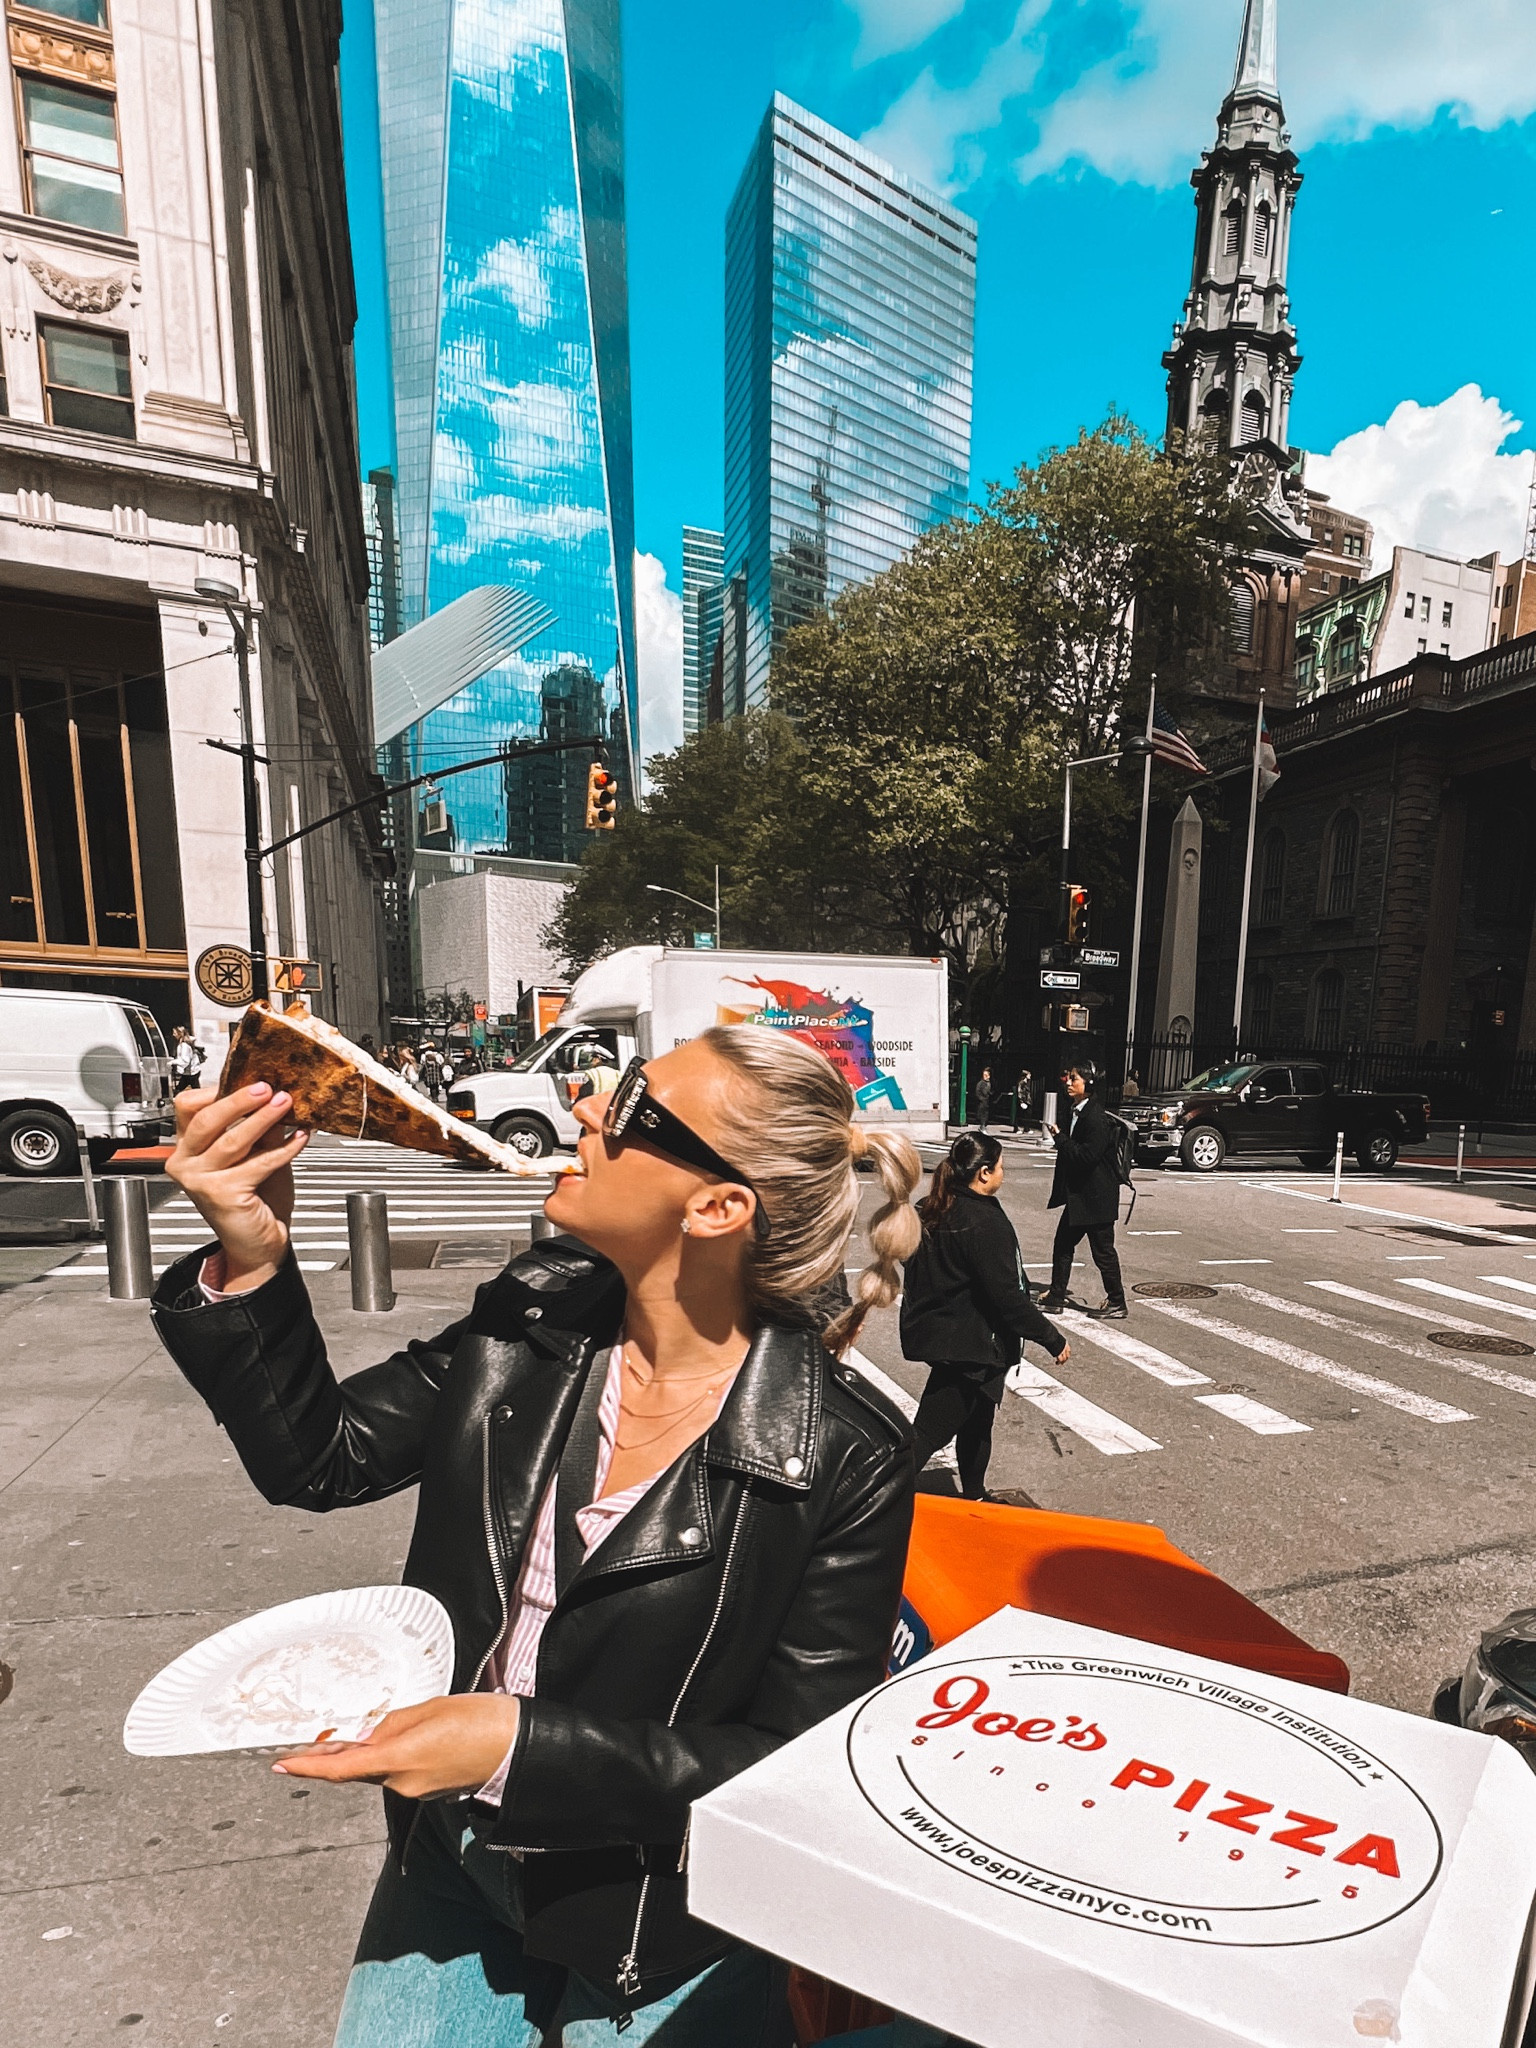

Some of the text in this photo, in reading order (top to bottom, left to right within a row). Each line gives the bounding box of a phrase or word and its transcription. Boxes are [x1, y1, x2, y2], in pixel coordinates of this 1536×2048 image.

[1085, 953, 1117, 965] Broadway
[860, 1057, 897, 1068] BAYSIDE
[867, 1040, 914, 1051] WOODSIDE
[1023, 1660, 1372, 1770] The Greenwich Village Institution
[915, 1676, 1401, 1879] Joe's PIZZA
[900, 1806, 1213, 1932] www.joespizzanyc.com
[1177, 1830, 1361, 1900] 1975
